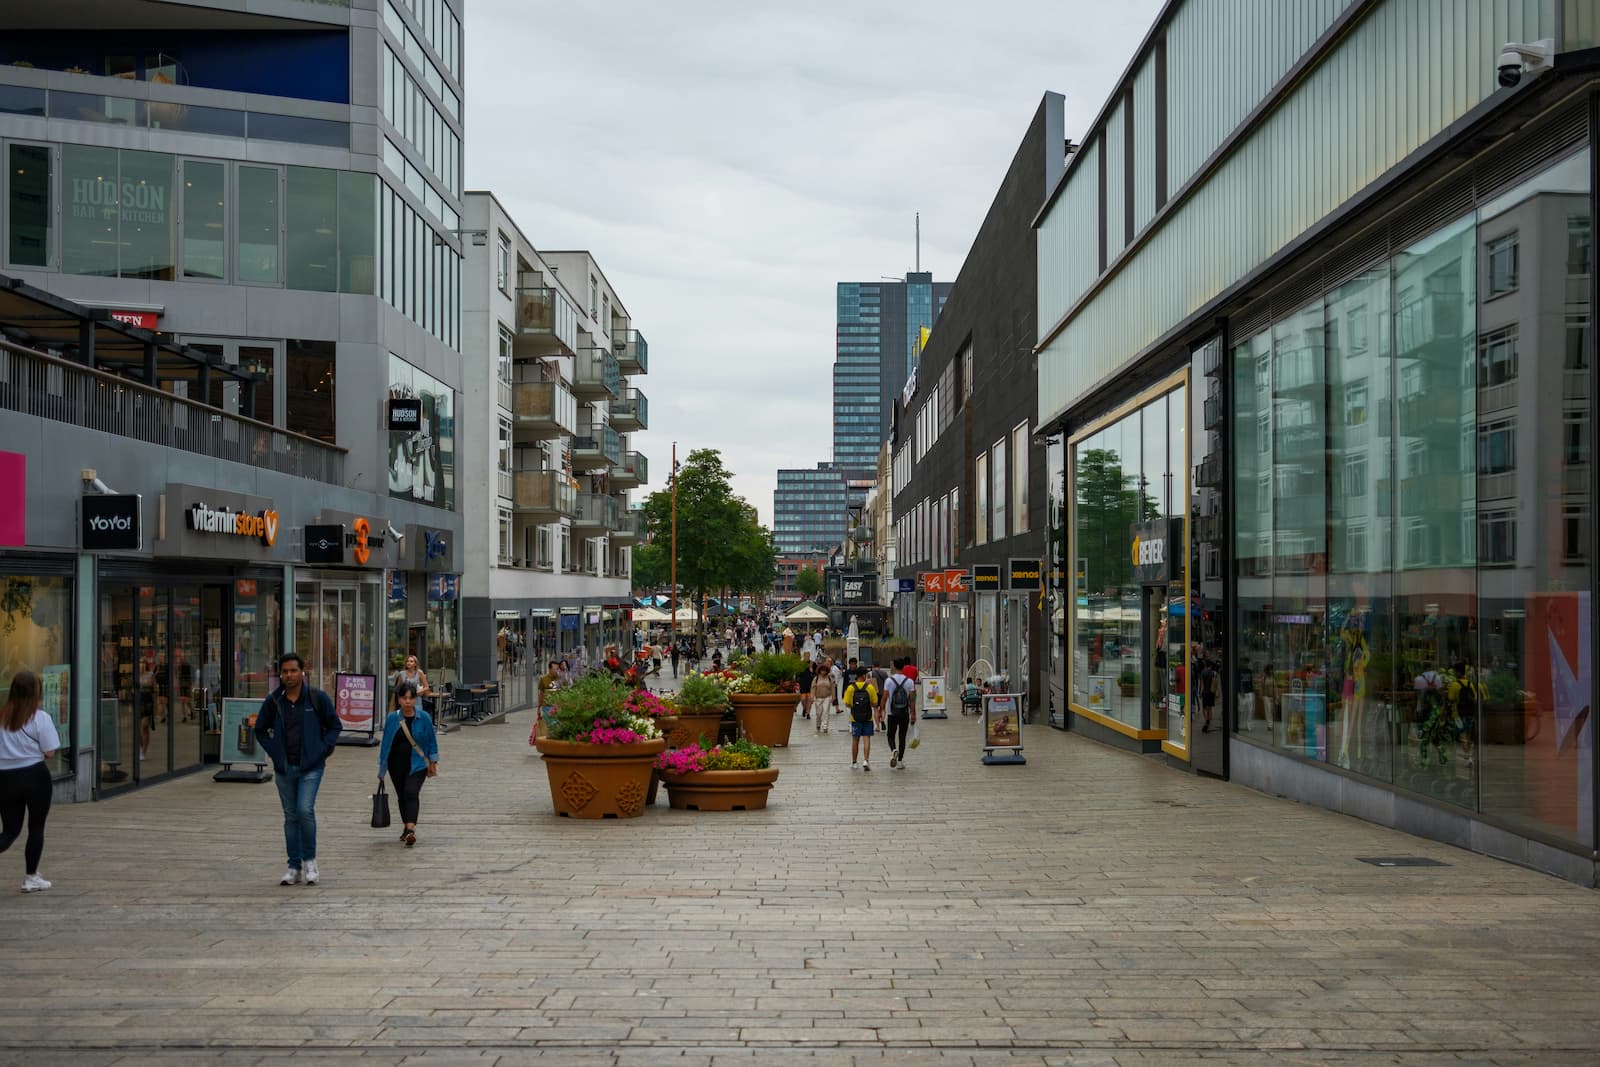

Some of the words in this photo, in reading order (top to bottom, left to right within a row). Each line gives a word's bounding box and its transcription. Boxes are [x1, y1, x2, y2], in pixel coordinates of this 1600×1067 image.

[72, 178, 165, 210] HUDSON
[72, 204, 96, 219] BAR
[122, 209, 165, 224] KITCHEN
[392, 409, 417, 418] HUDSON
[192, 502, 264, 537] vitaminstore
[1139, 539, 1164, 566] BEVER
[844, 581, 863, 591] EASY
